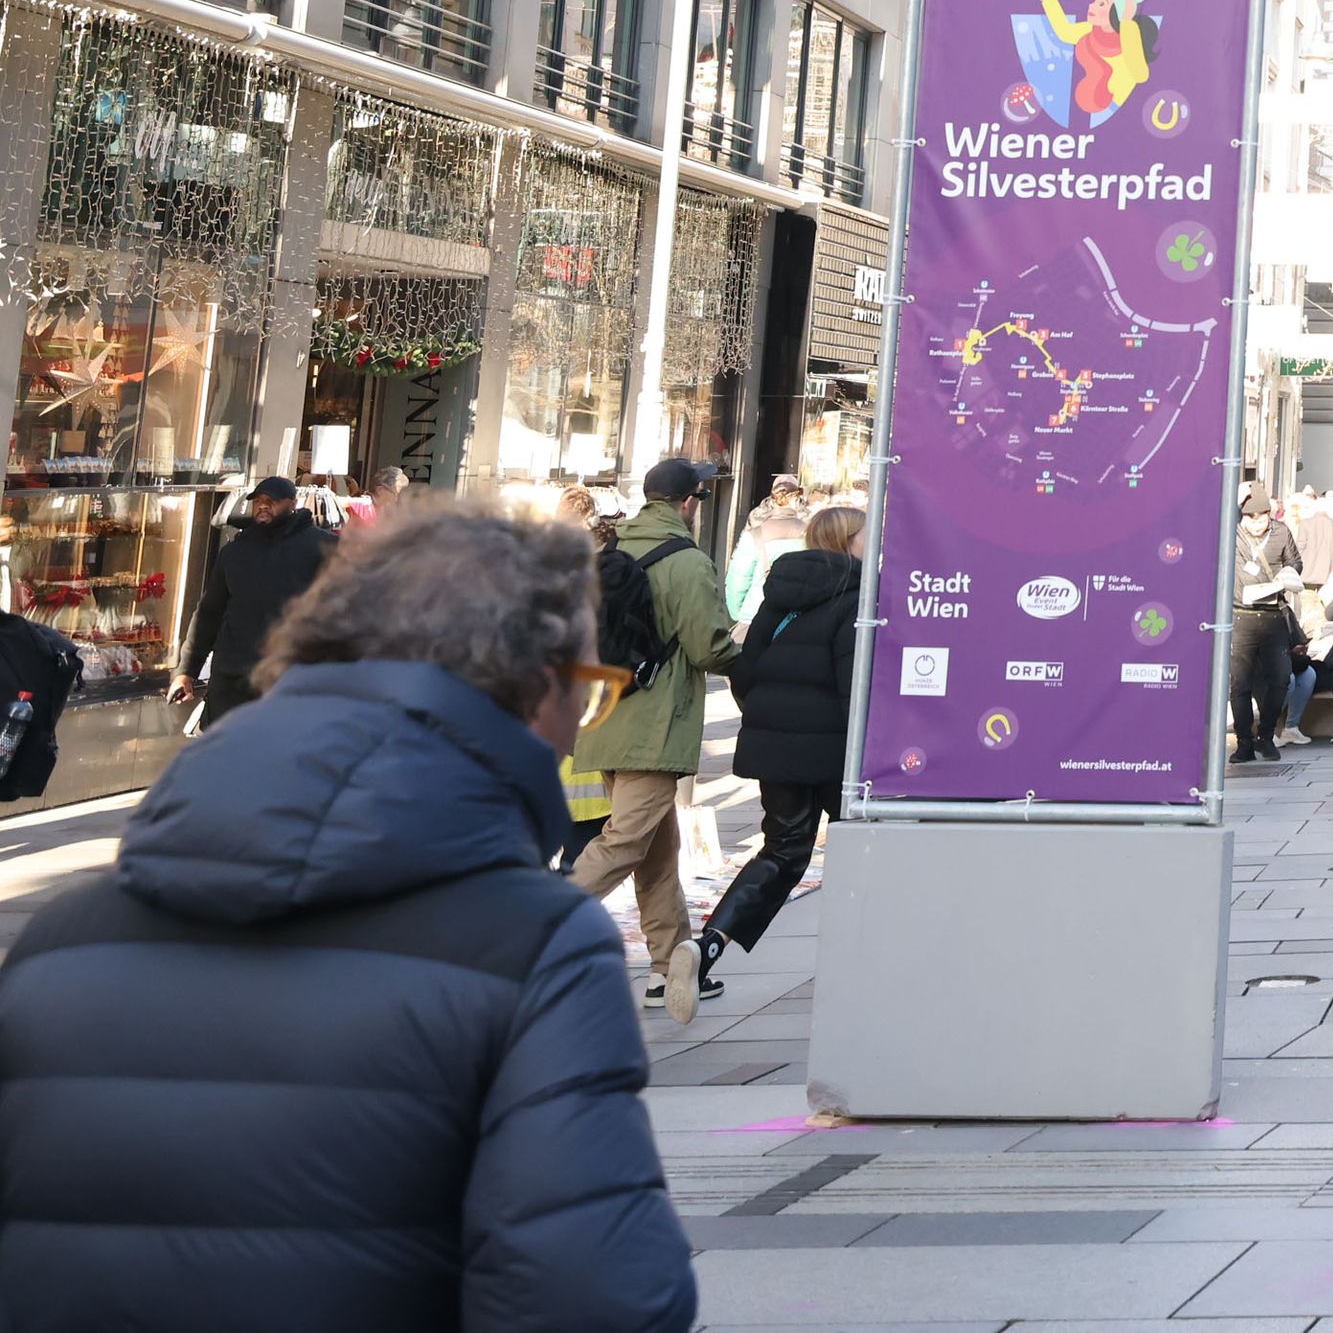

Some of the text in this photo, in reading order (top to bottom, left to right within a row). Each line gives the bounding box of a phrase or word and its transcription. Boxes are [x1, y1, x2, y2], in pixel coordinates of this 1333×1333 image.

[944, 122, 1095, 159] Wiener
[940, 161, 1212, 210] Silvesterpfad
[908, 570, 971, 593] Stadt
[1108, 575, 1131, 583] Für die
[1027, 584, 1070, 597] Wien
[1127, 584, 1145, 592] Wien
[907, 596, 969, 618] Wien
[1125, 666, 1178, 680] RADIO W
[1060, 759, 1172, 773] wienersilvesterpfad.at
